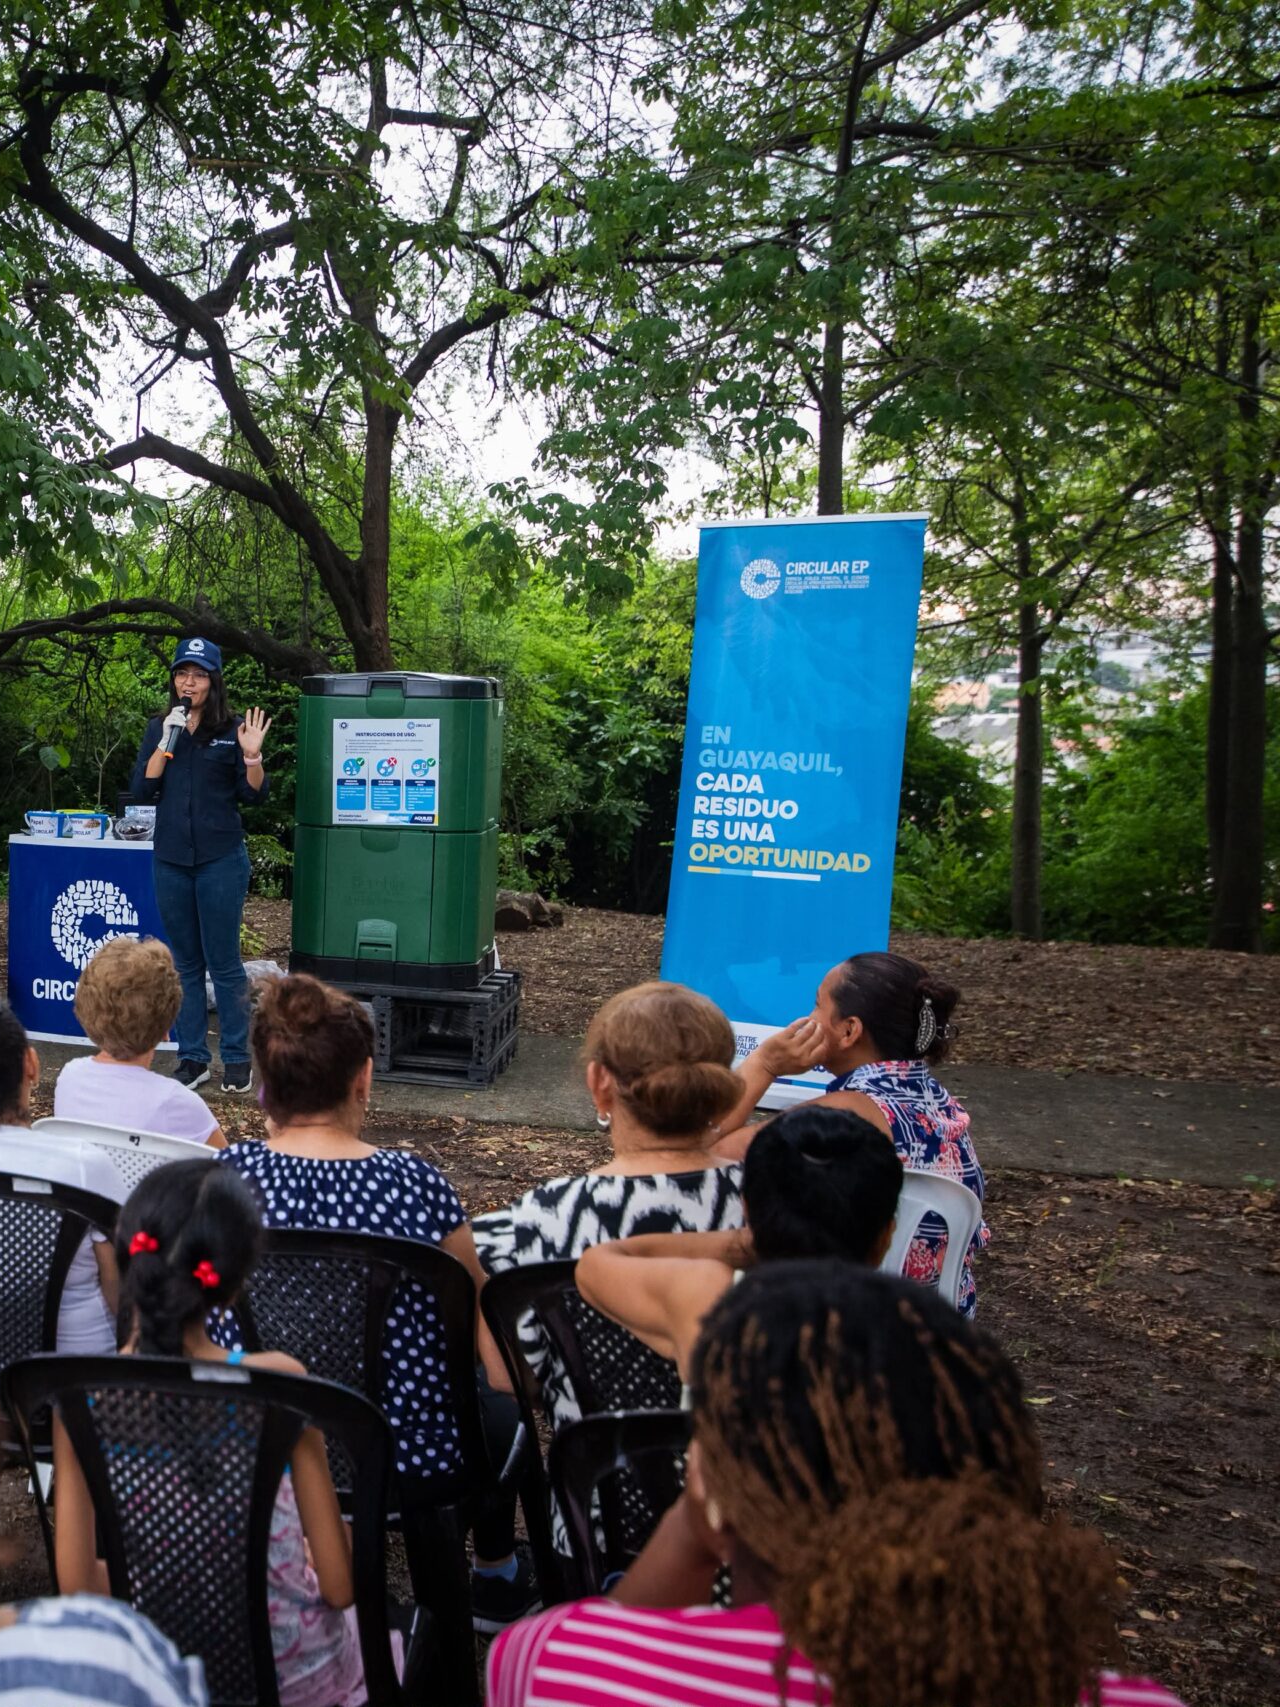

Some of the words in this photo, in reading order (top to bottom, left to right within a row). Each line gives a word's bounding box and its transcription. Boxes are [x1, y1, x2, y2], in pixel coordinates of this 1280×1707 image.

[785, 561, 849, 576] CIRCULAR
[851, 560, 870, 574] EP
[701, 725, 732, 745] EN
[698, 748, 843, 777] GUAYAQUIL,
[696, 772, 764, 794] CADA
[693, 796, 799, 820] RESIDUO
[691, 819, 719, 839] ES
[723, 821, 775, 842] UNA
[689, 842, 871, 873] OPORTUNIDAD
[32, 977, 79, 1002] CIRC
[736, 1035, 758, 1043] USTRE
